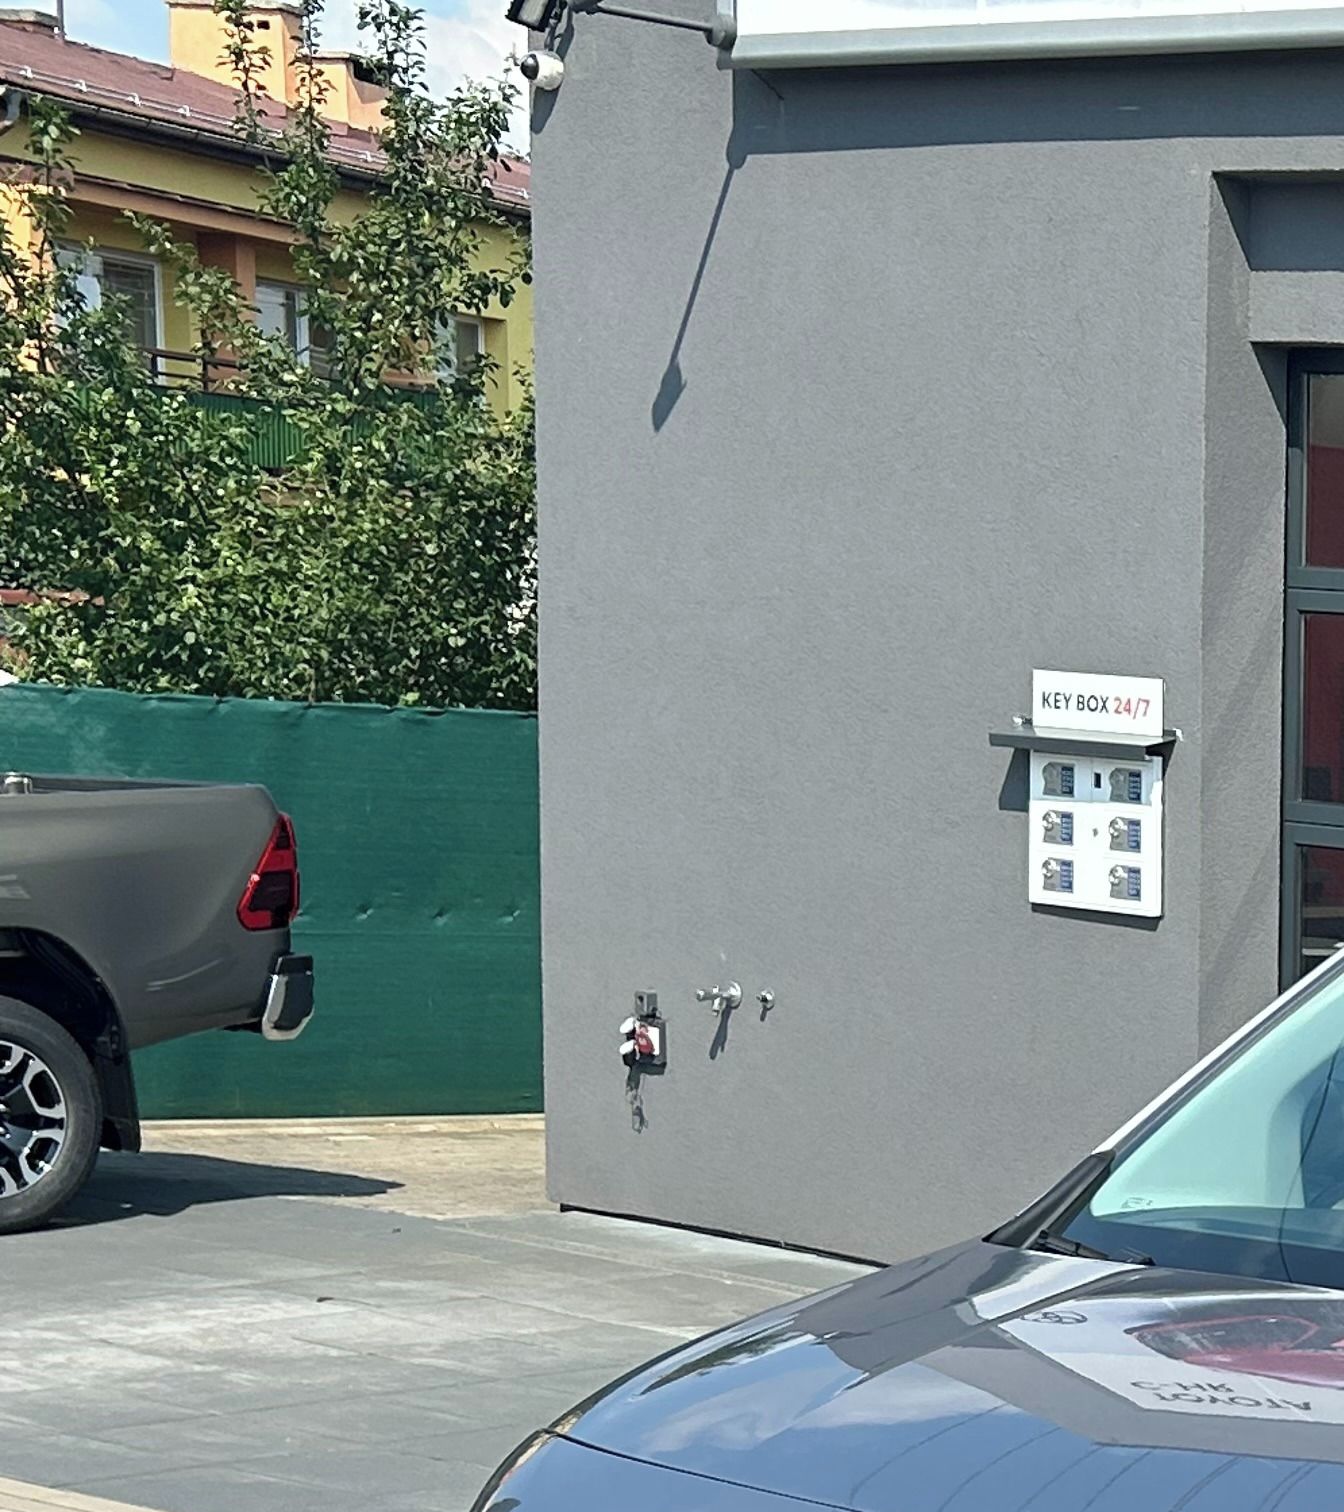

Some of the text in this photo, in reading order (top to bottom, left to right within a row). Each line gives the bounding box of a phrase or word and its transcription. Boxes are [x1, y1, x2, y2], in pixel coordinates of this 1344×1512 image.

[1041, 691, 1150, 720] KEY BOX 24/7
